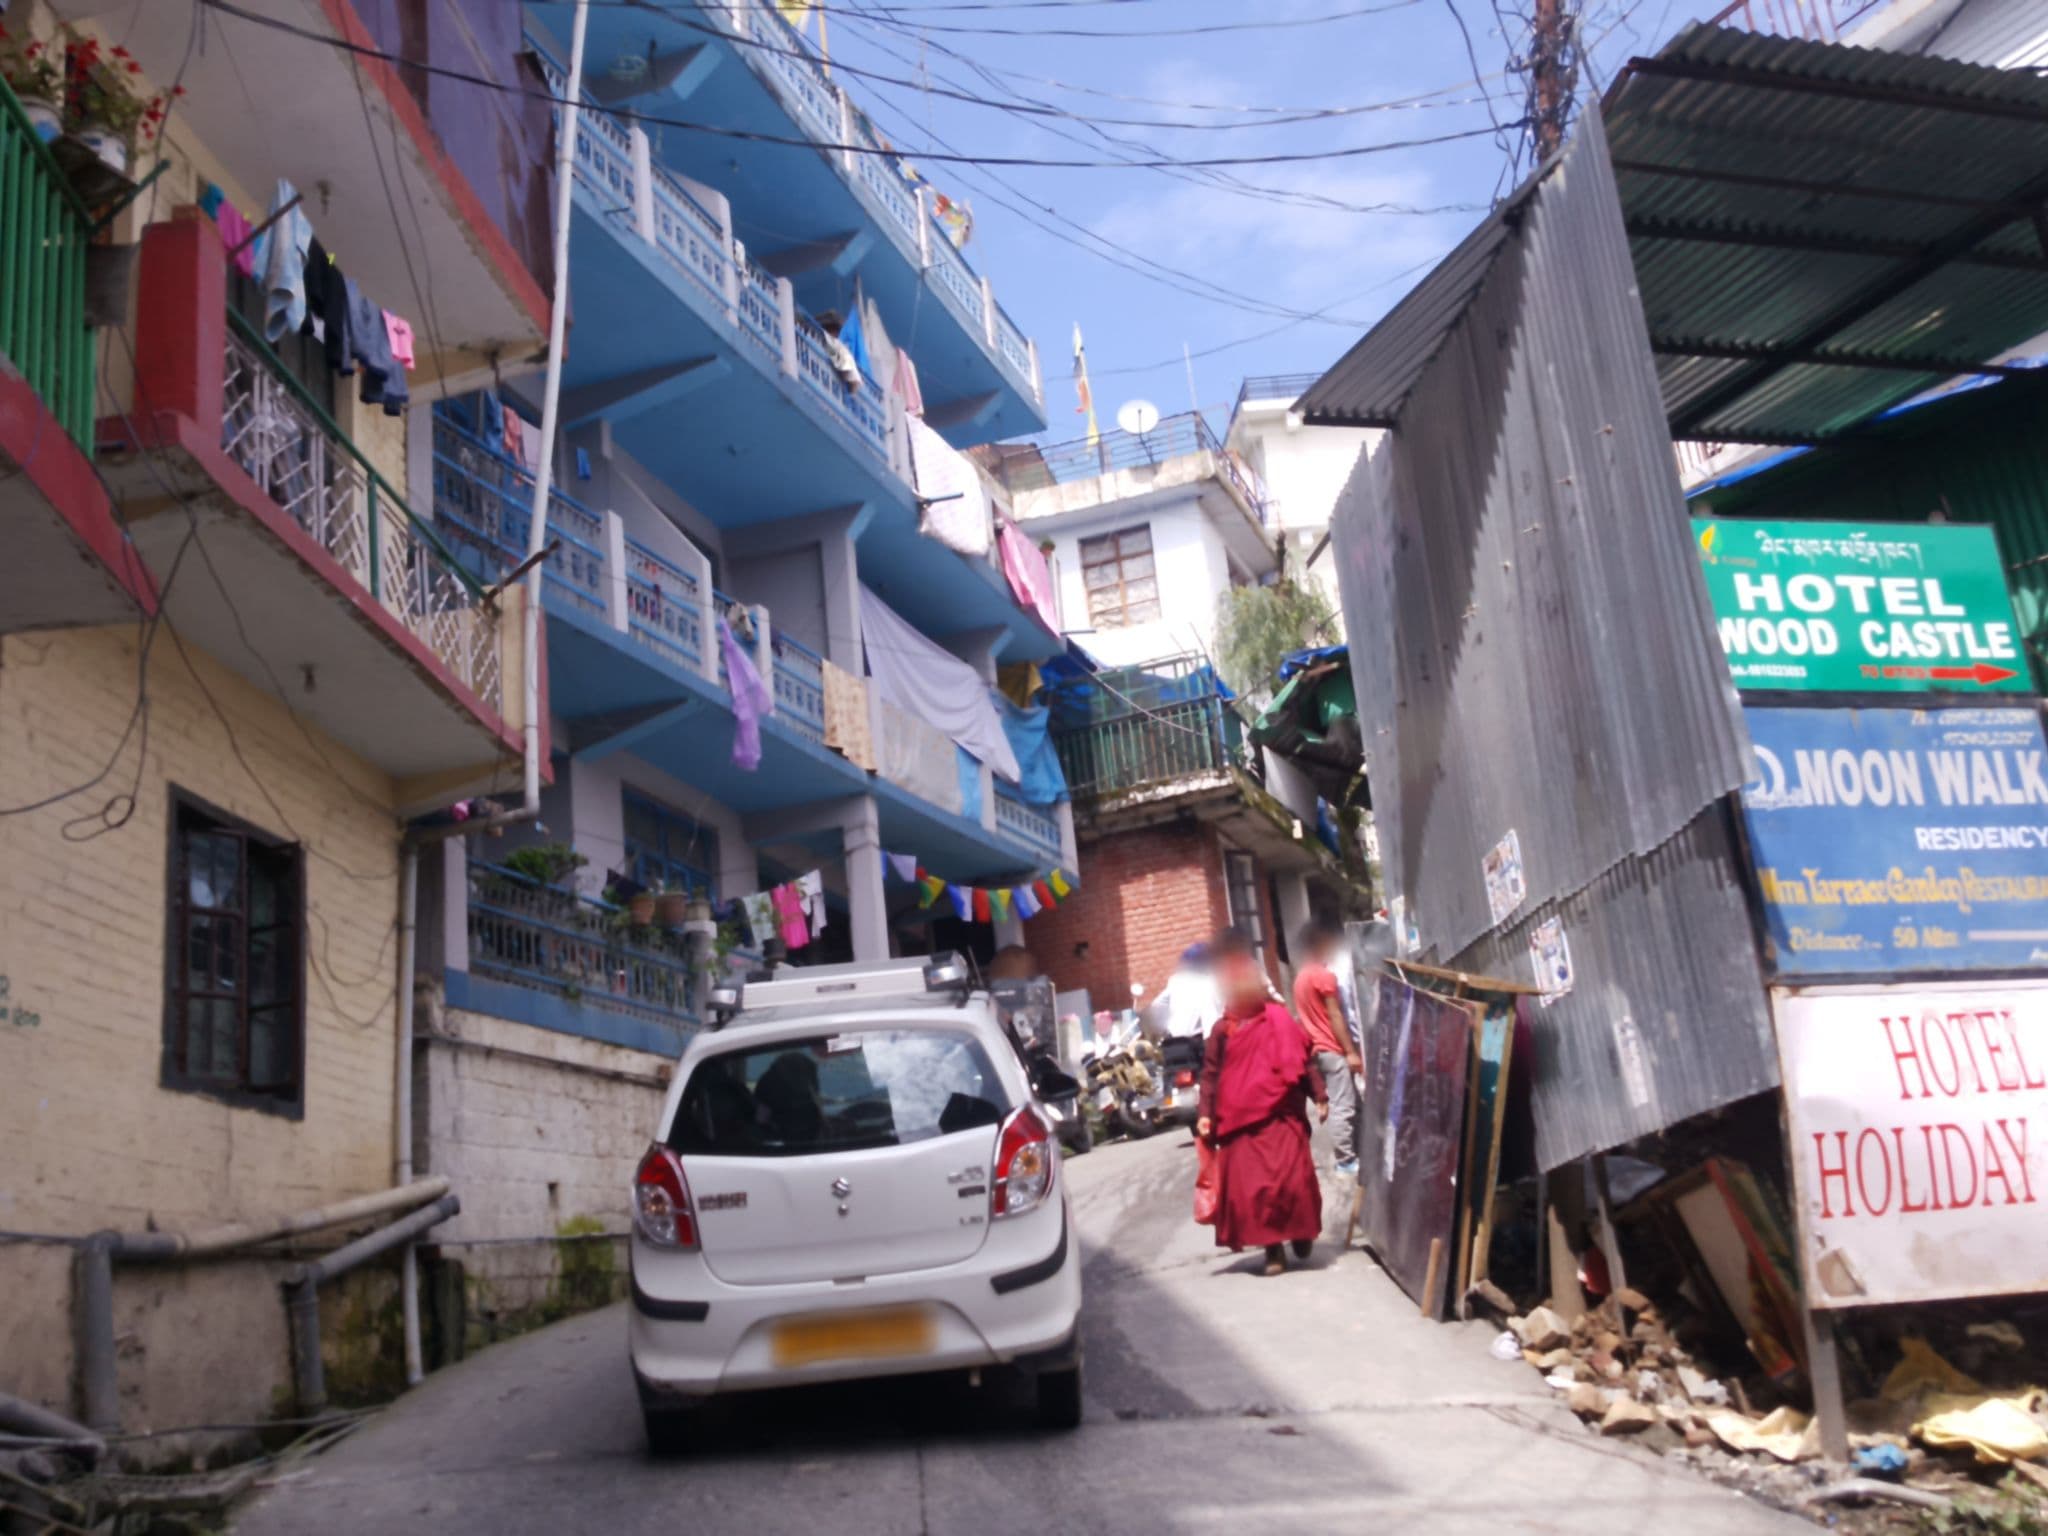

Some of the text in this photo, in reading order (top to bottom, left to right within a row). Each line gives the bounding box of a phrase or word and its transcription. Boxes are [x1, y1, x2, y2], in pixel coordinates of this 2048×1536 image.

[1733, 573, 1965, 616] HOTEL
[1718, 617, 2016, 659] WOOD CASTLE
[1794, 749, 2048, 807] MOON WALK
[1914, 827, 2048, 851] RESIDENCY
[1880, 1008, 2046, 1100] HOTEL
[1812, 1117, 2037, 1219] HOLIDAY
